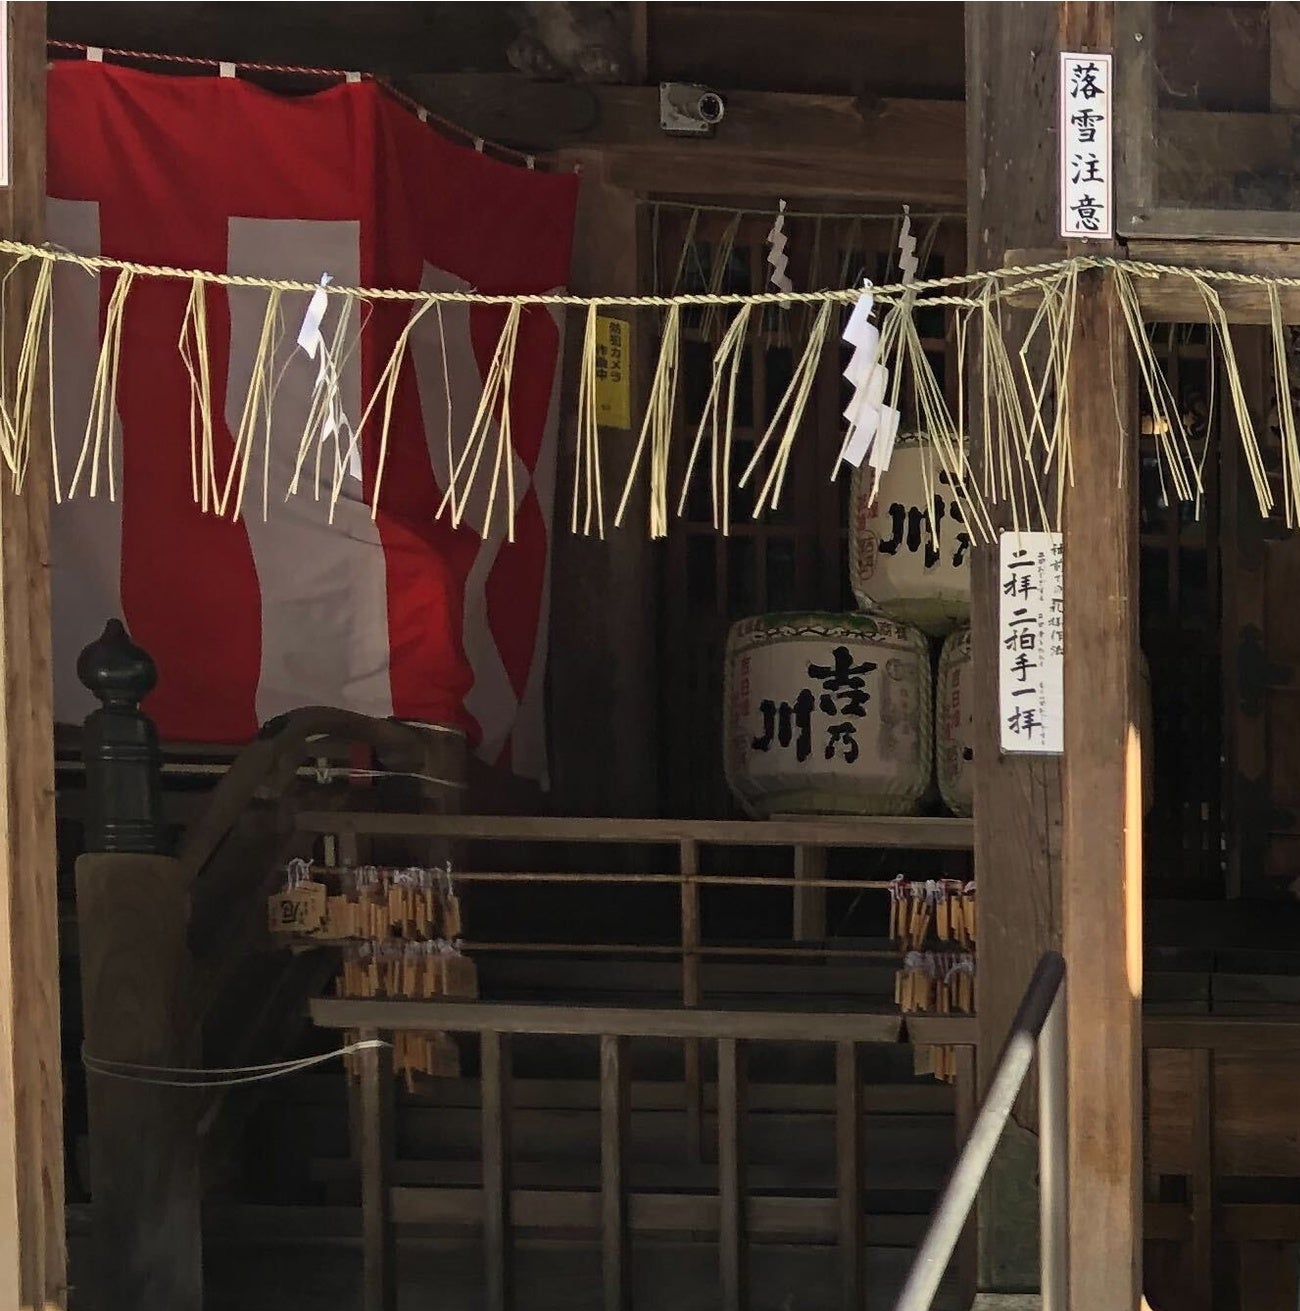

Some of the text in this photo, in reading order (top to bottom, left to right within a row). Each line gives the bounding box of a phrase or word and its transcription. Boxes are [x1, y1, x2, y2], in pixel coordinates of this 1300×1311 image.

[1070, 62, 1105, 231] 落雪注意
[1003, 550, 1043, 741] 二拝二拍手一拝
